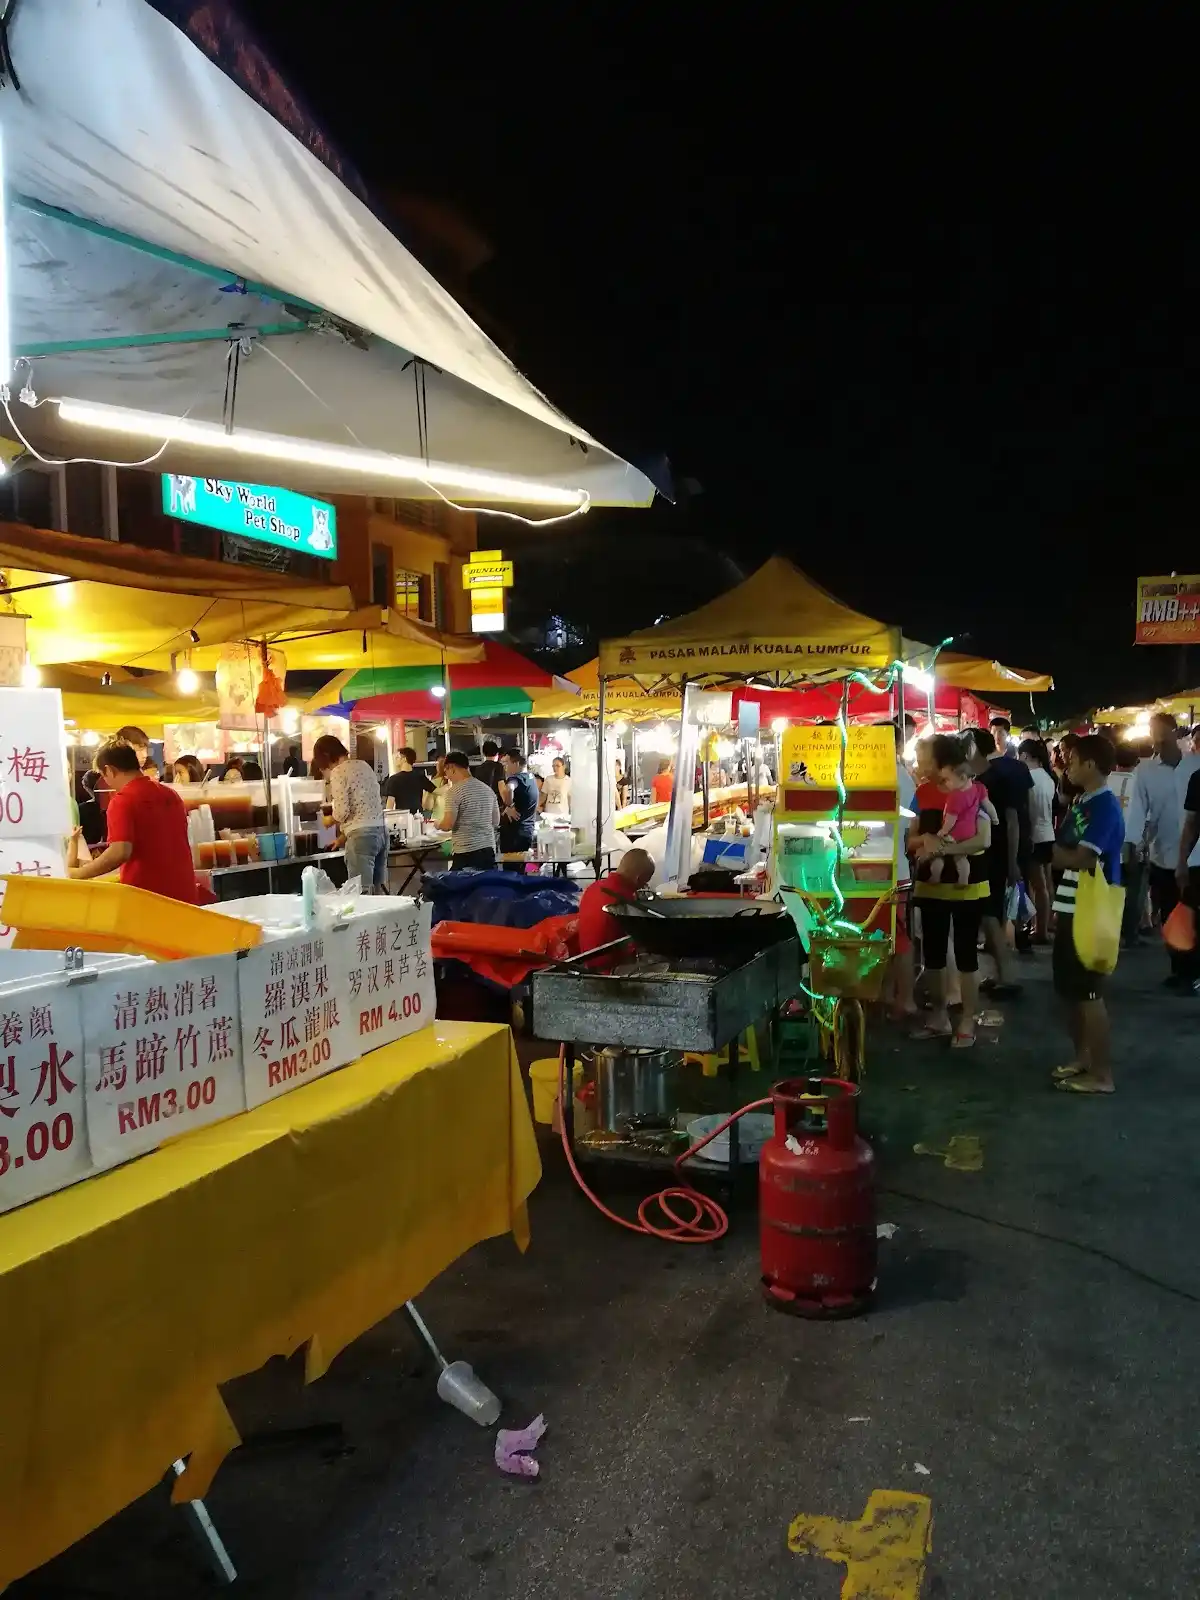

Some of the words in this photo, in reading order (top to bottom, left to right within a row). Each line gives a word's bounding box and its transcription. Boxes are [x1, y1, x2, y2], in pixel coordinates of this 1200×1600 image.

[205, 478, 232, 501] Sky
[236, 486, 276, 512] World
[245, 509, 266, 529] Pet
[270, 517, 300, 541] Shop
[469, 567, 510, 575] DUNLOP
[650, 648, 695, 660] PASAR
[698, 644, 750, 657] MALAM
[753, 643, 803, 655] KUALA
[807, 644, 871, 655] LUMPUR
[583, 692, 614, 700] MALM
[616, 691, 646, 699] KUALA
[0, 746, 50, 783] 梅
[852, 743, 886, 751] POPIAH
[264, 964, 329, 1019] 羅漢果
[349, 949, 428, 997] 罗汉果芦荟
[112, 974, 219, 1031] 清熱消暑
[359, 1004, 384, 1036] RM
[387, 992, 422, 1022] 4.00
[252, 997, 341, 1060] 冬瓜龍眼
[94, 1015, 234, 1093] 馬蹄竹蔗
[268, 1037, 331, 1088] RM3.00
[117, 1075, 216, 1135] RM3.00
